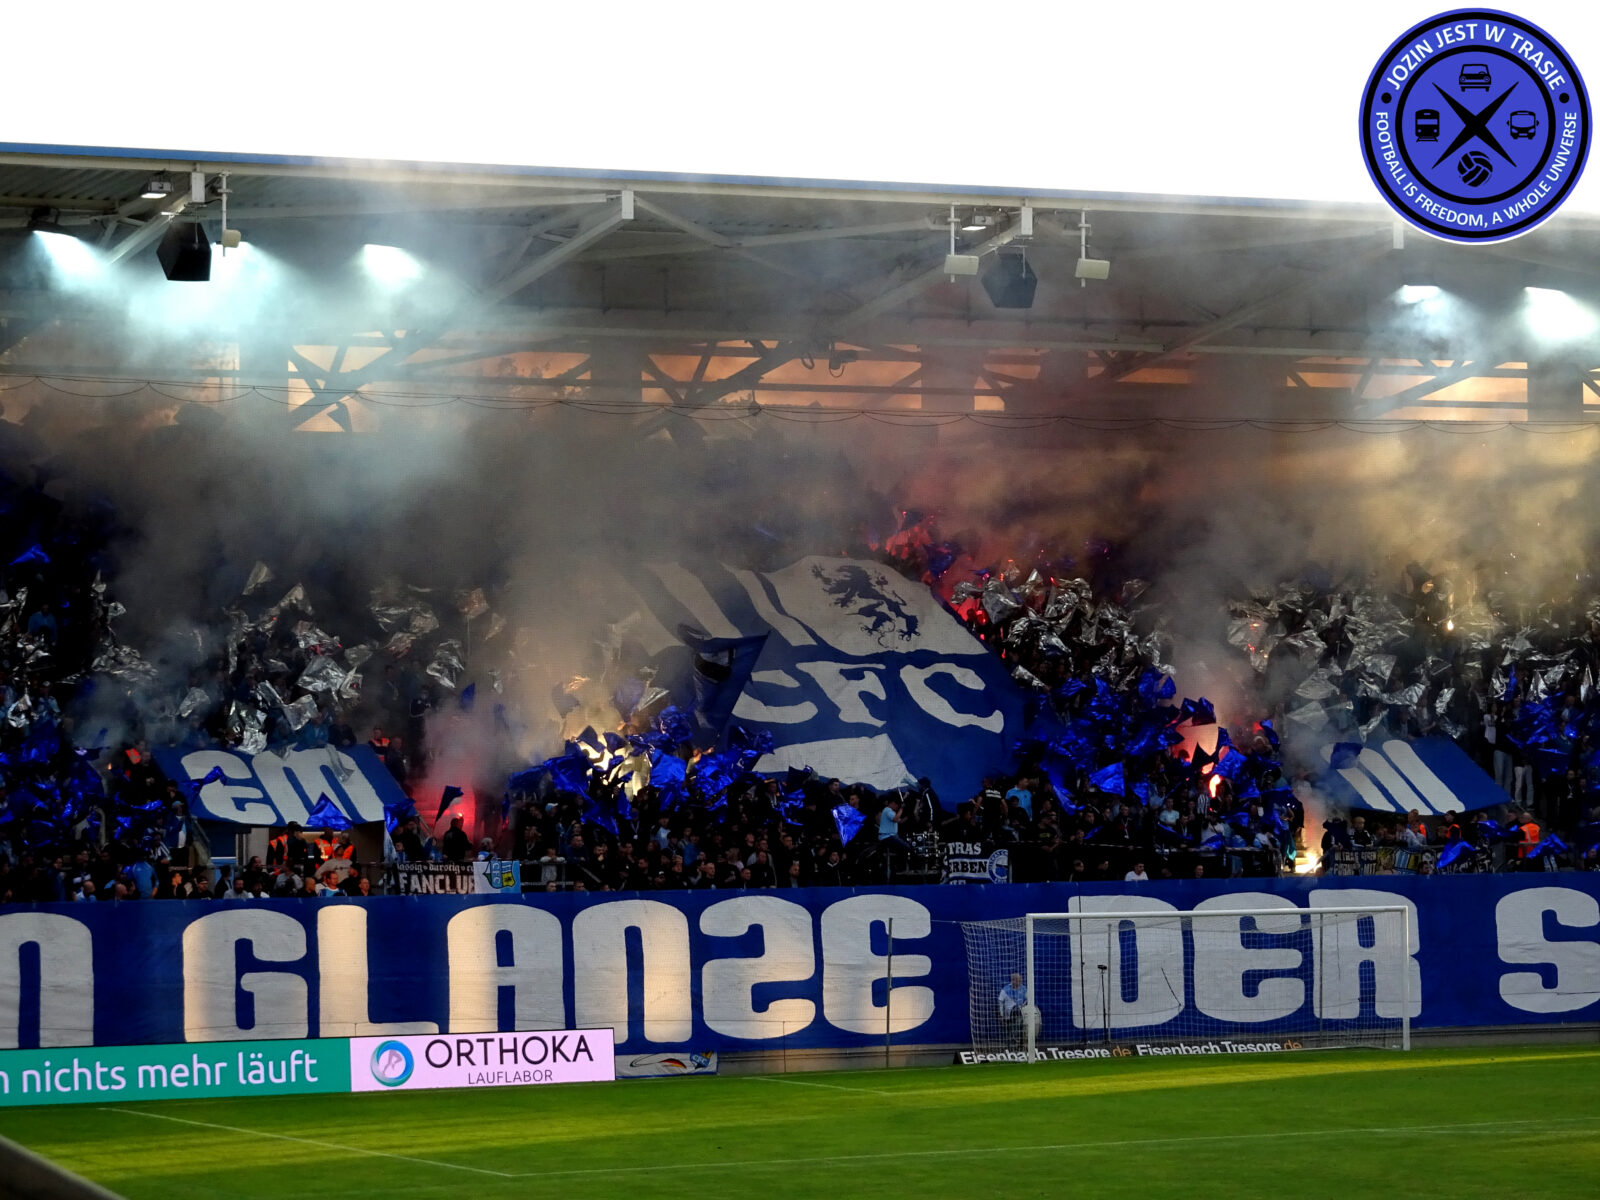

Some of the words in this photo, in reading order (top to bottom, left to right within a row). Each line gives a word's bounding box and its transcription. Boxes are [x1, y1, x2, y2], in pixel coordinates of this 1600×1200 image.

[1068, 889, 1422, 1029] DER
[424, 1035, 594, 1069] ORTHOKA
[1136, 1041, 1218, 1056] Eisenbach
[22, 1058, 127, 1093] nichts
[138, 1053, 228, 1088] mehr
[237, 1049, 319, 1085] läuft
[467, 1069, 553, 1085] LAUFLABOR
